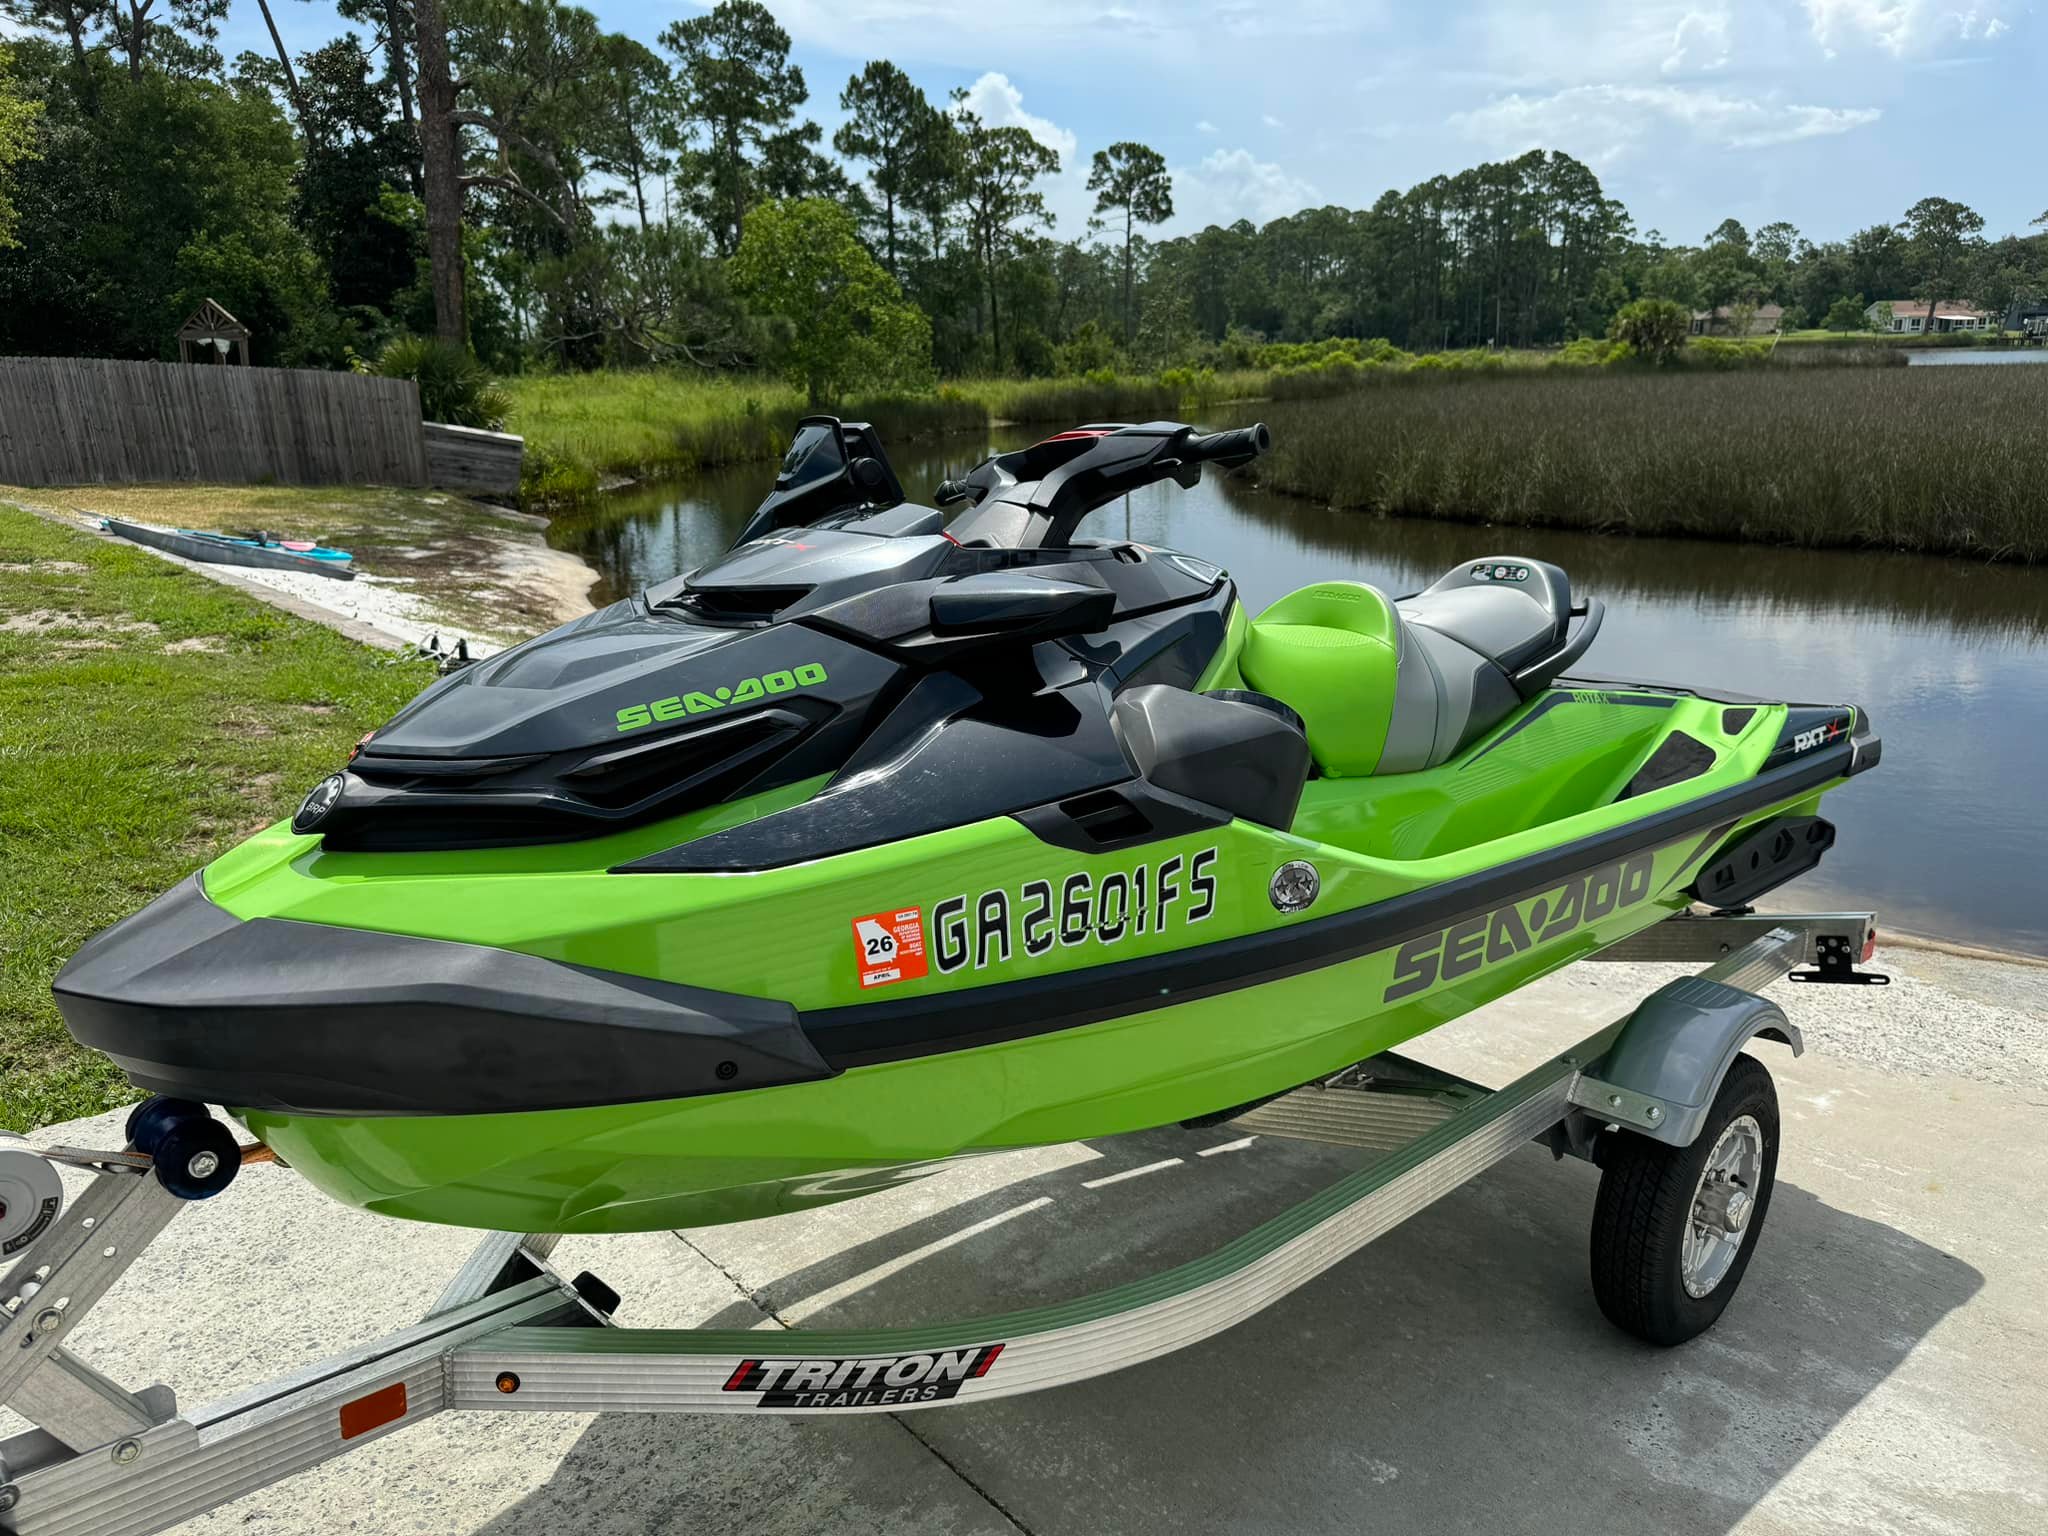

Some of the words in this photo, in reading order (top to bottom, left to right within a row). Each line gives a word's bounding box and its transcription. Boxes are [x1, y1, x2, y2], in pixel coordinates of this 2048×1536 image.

[305, 801, 326, 814] BRP
[866, 935, 893, 956] 26
[756, 1348, 982, 1390] TRITON
[794, 1385, 939, 1406] TRAILERS
